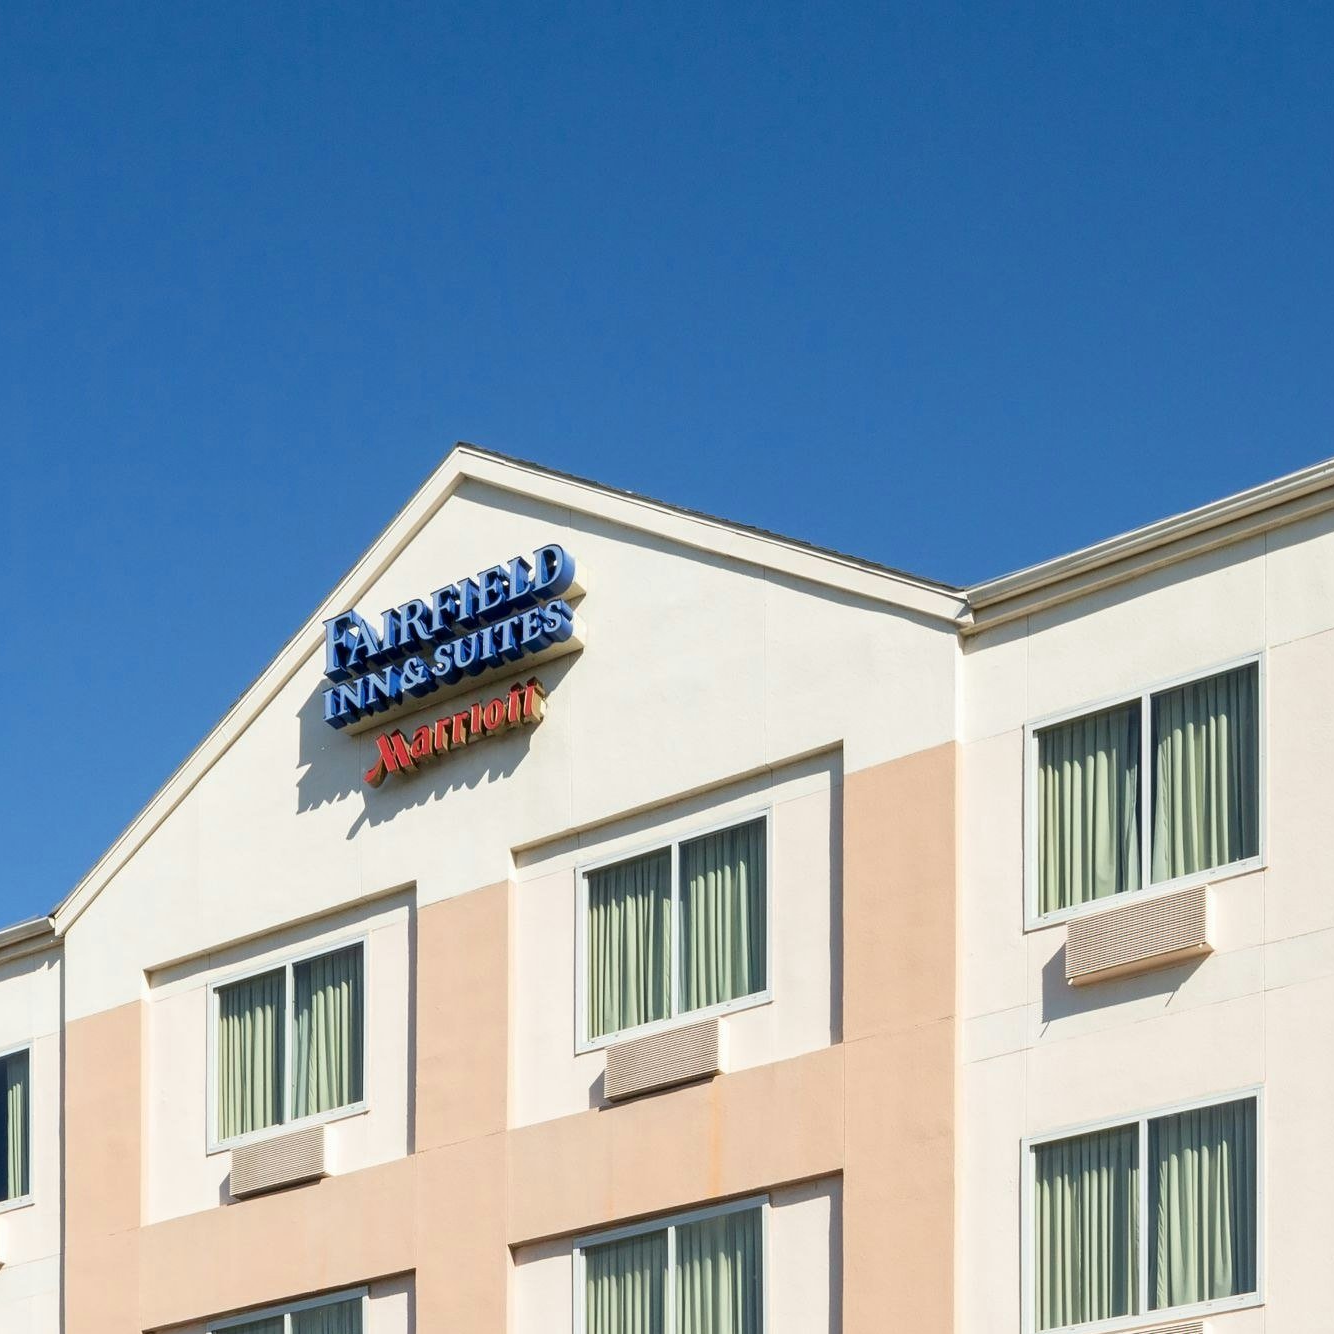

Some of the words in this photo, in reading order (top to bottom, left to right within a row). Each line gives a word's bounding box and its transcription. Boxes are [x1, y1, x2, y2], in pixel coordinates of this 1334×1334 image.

[322, 543, 573, 681] FAIRFIELD
[322, 668, 403, 730] INN
[398, 657, 433, 696] &
[432, 598, 572, 684] SUITES
[363, 678, 544, 787] Marriott
